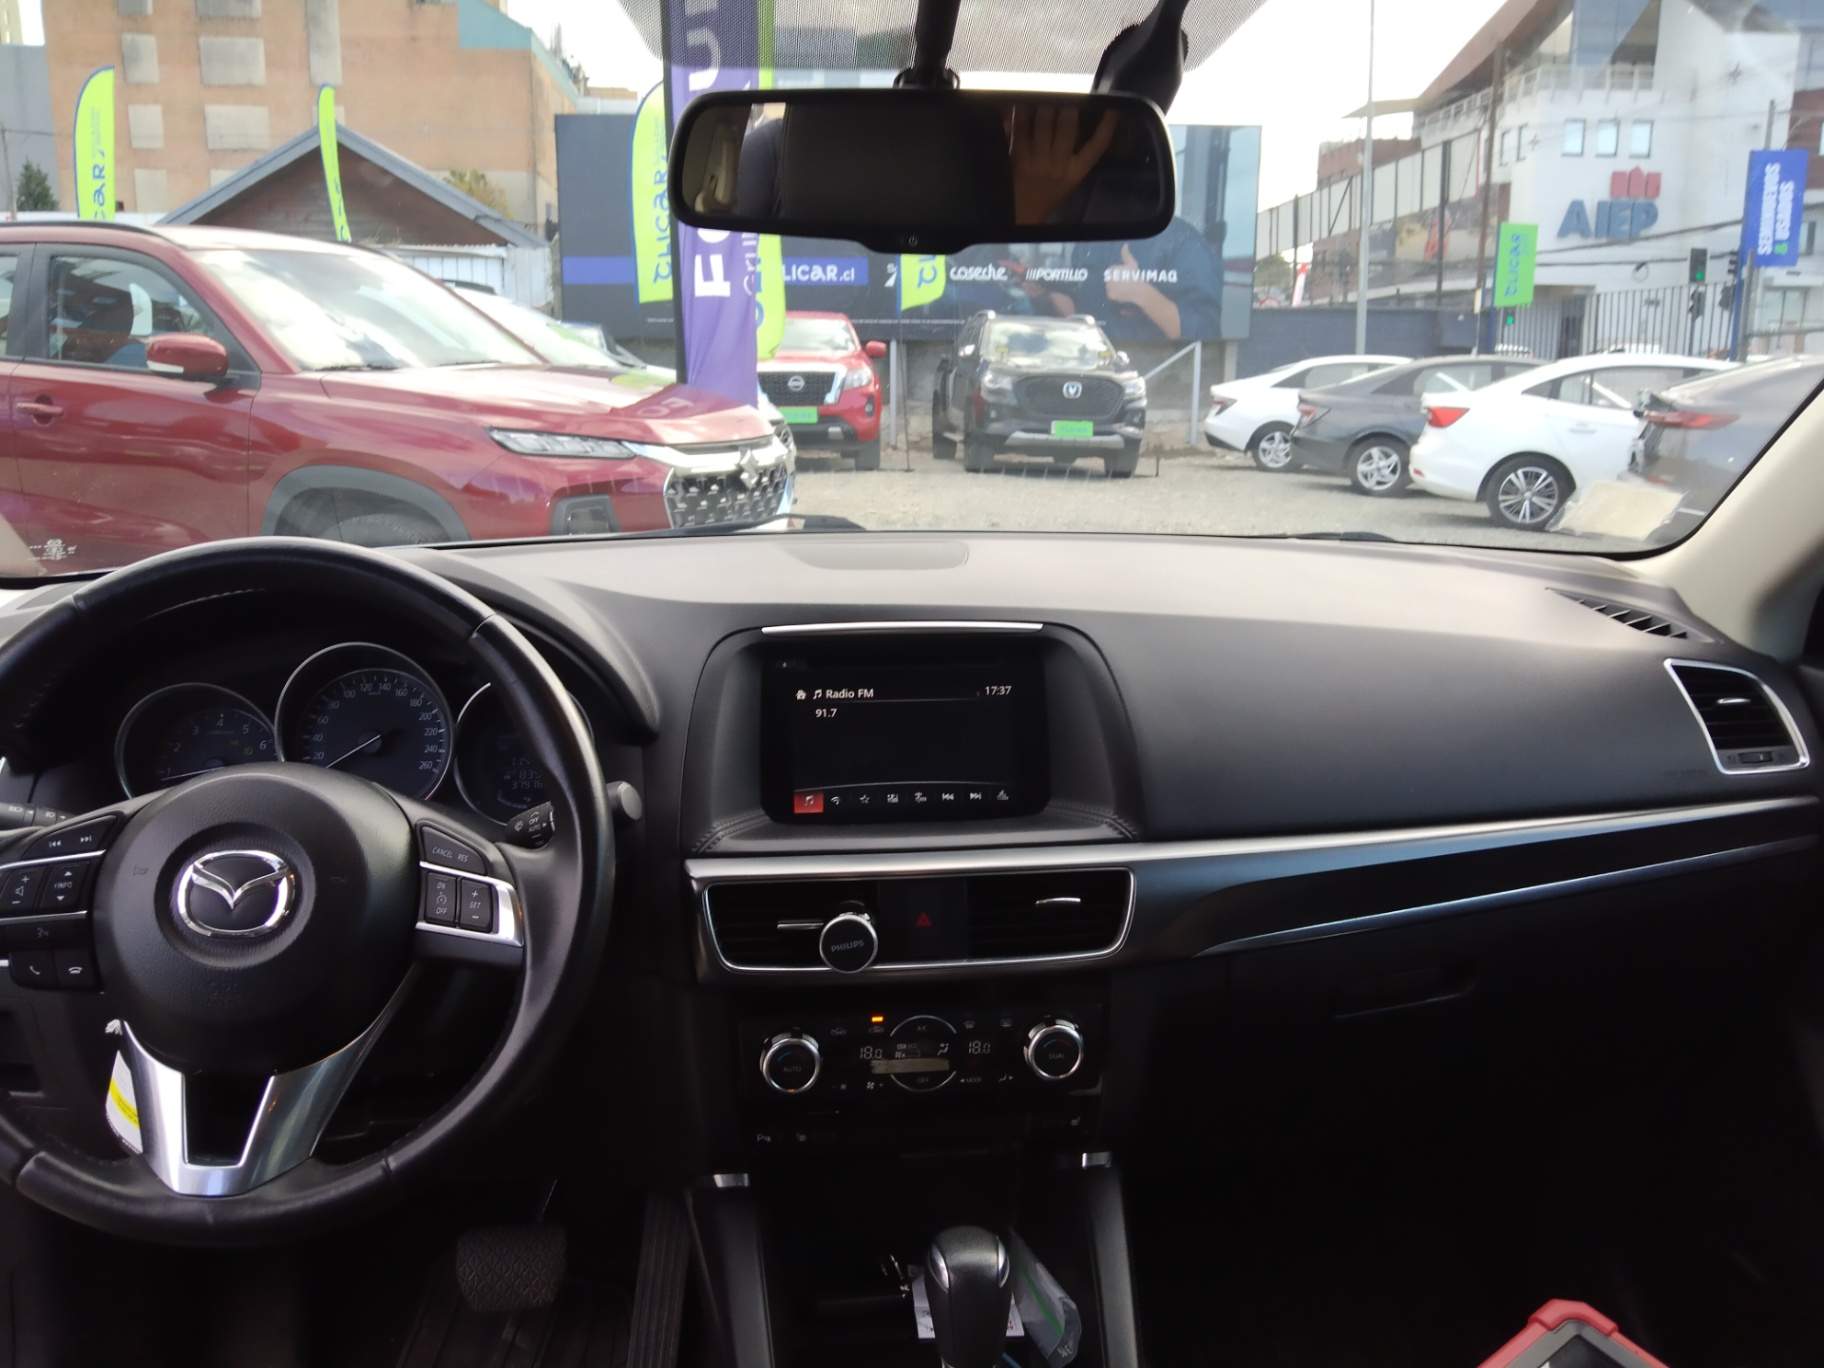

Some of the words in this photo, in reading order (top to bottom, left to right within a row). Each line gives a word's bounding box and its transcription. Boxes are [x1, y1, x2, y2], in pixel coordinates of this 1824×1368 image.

[1557, 198, 1659, 241] AIEP
[1103, 268, 1178, 283] SERVIMAQ
[825, 688, 855, 700] Radio
[858, 688, 874, 698] FM
[984, 686, 1012, 696] 17:37
[418, 712, 433, 721] 200
[815, 708, 837, 718] 91.7
[424, 728, 438, 736] 220
[259, 740, 267, 750] 6
[418, 762, 433, 770] 260
[432, 846, 453, 858] CANCEL
[458, 853, 468, 863] RES
[56, 881, 73, 889] INFO
[436, 882, 446, 890] ON
[469, 901, 481, 909] SET
[435, 907, 448, 915] OFF
[831, 940, 865, 952] PHILIPS
[968, 1040, 991, 1055] 18.0
[859, 1046, 883, 1060] 18.0
